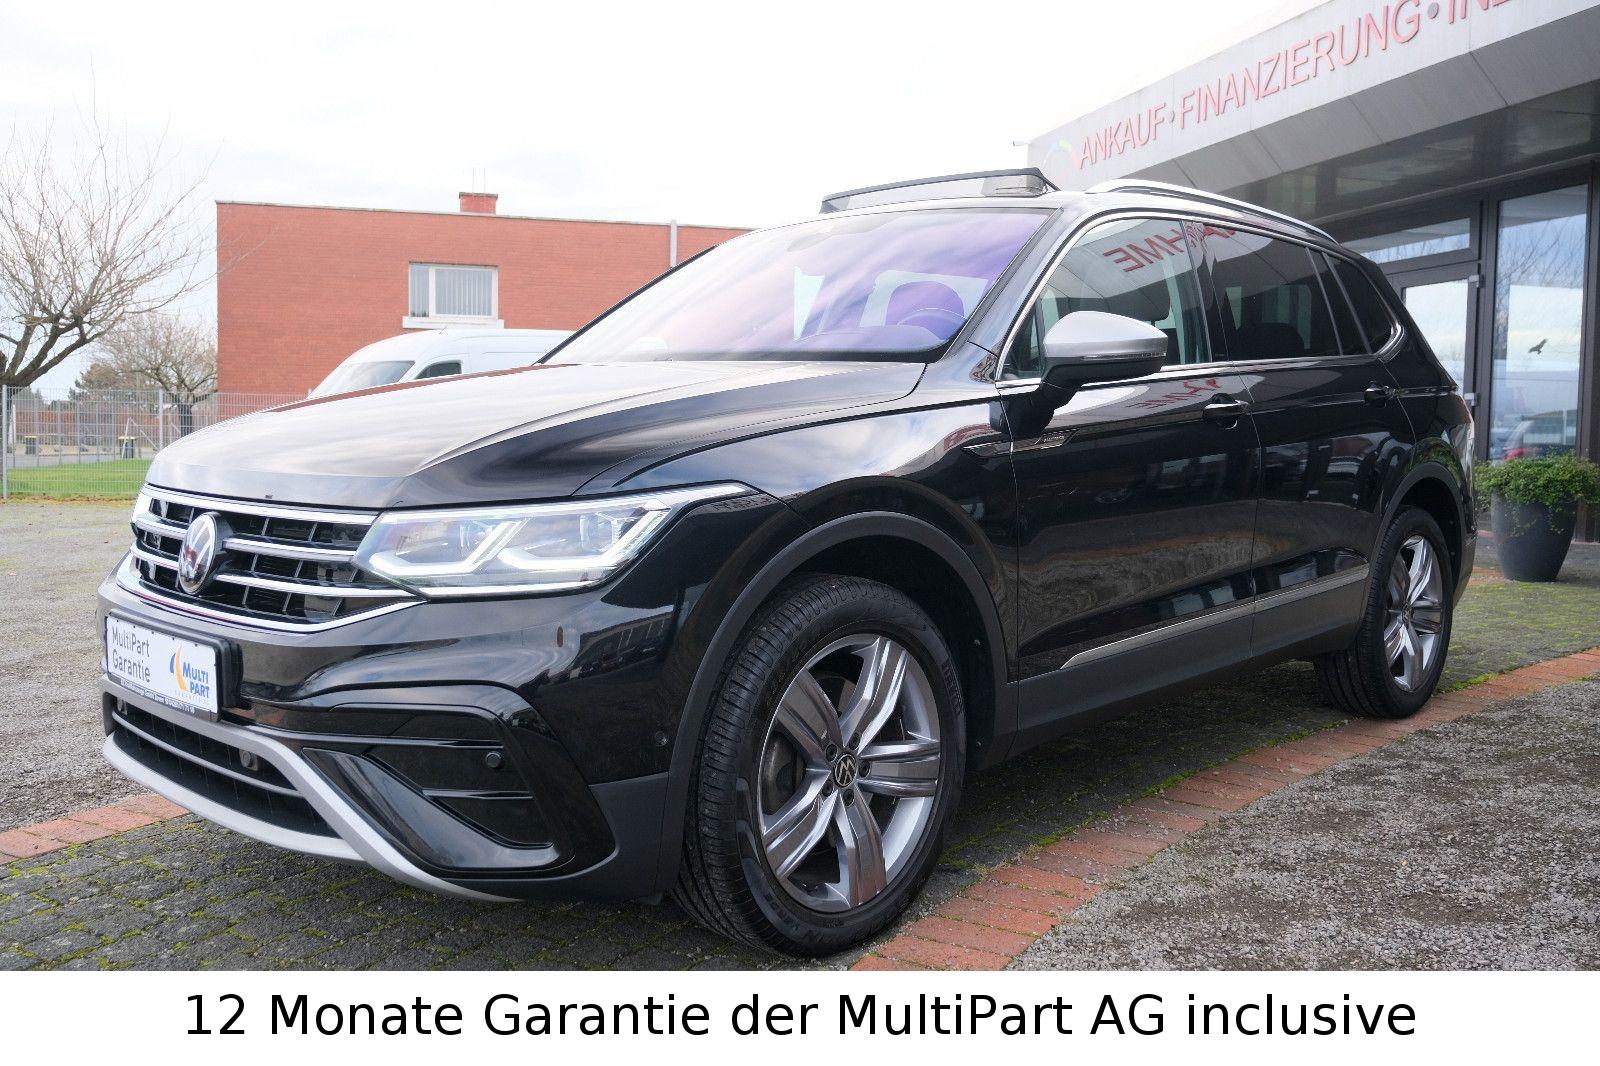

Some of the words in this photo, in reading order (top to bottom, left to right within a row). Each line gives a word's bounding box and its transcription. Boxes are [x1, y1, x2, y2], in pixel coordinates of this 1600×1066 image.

[1079, 102, 1167, 170] ANKAUF
[1179, 0, 1420, 129] FINANZIERUNG
[112, 625, 150, 658] MultiPart
[112, 649, 151, 683] Garantie
[190, 682, 210, 698] PART
